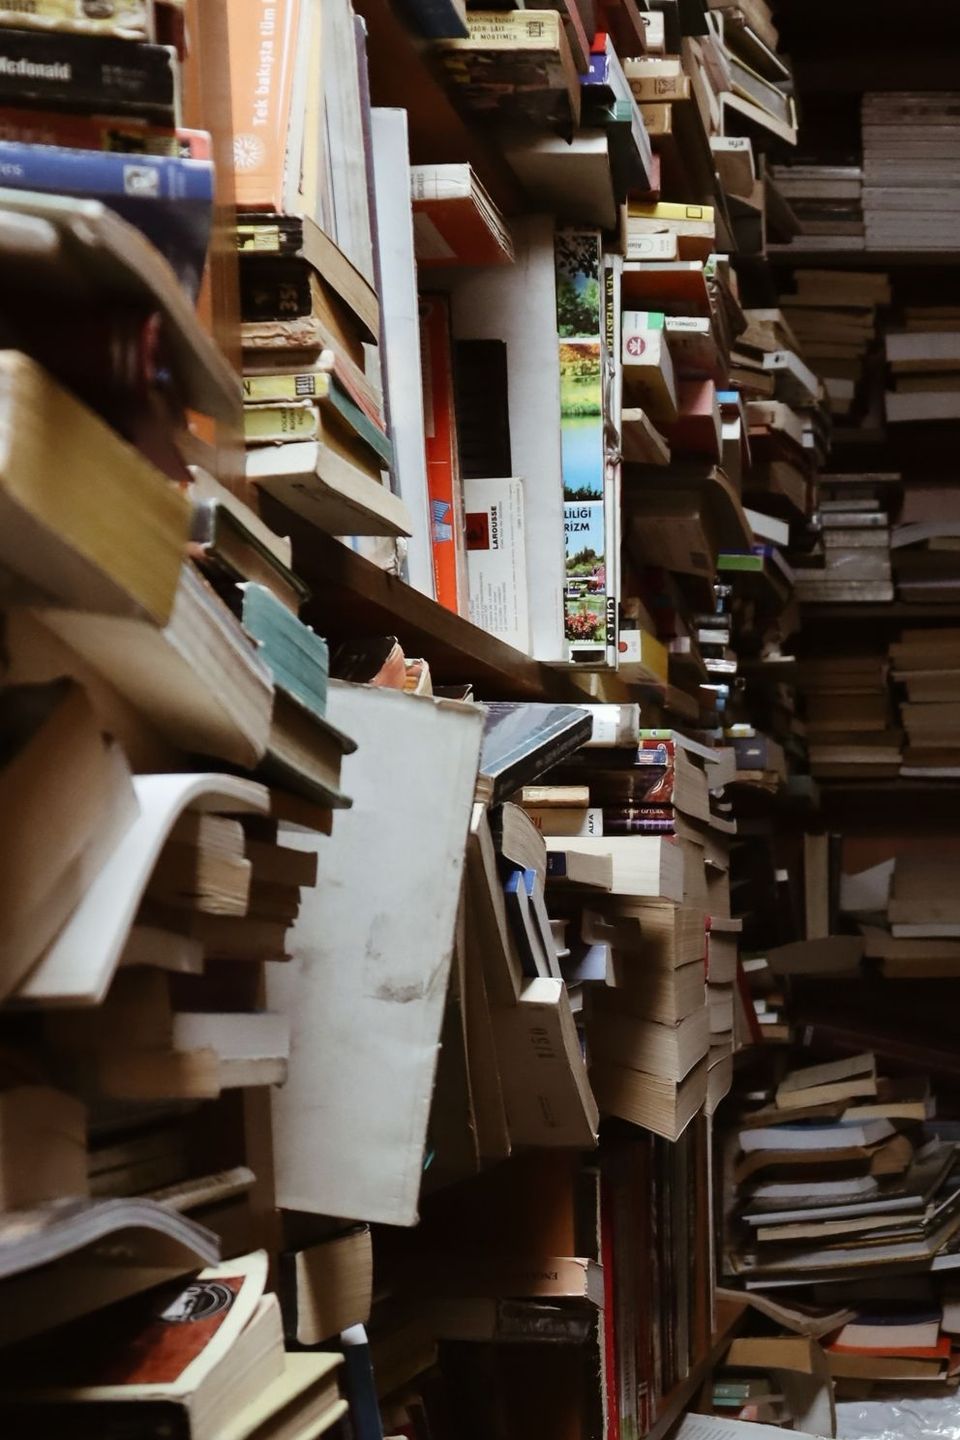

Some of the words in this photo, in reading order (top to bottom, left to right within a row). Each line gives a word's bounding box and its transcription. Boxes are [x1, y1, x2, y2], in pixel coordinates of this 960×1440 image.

[260, 8, 276, 35] tüm
[256, 41, 274, 93] bakışta
[253, 101, 268, 125] Tek
